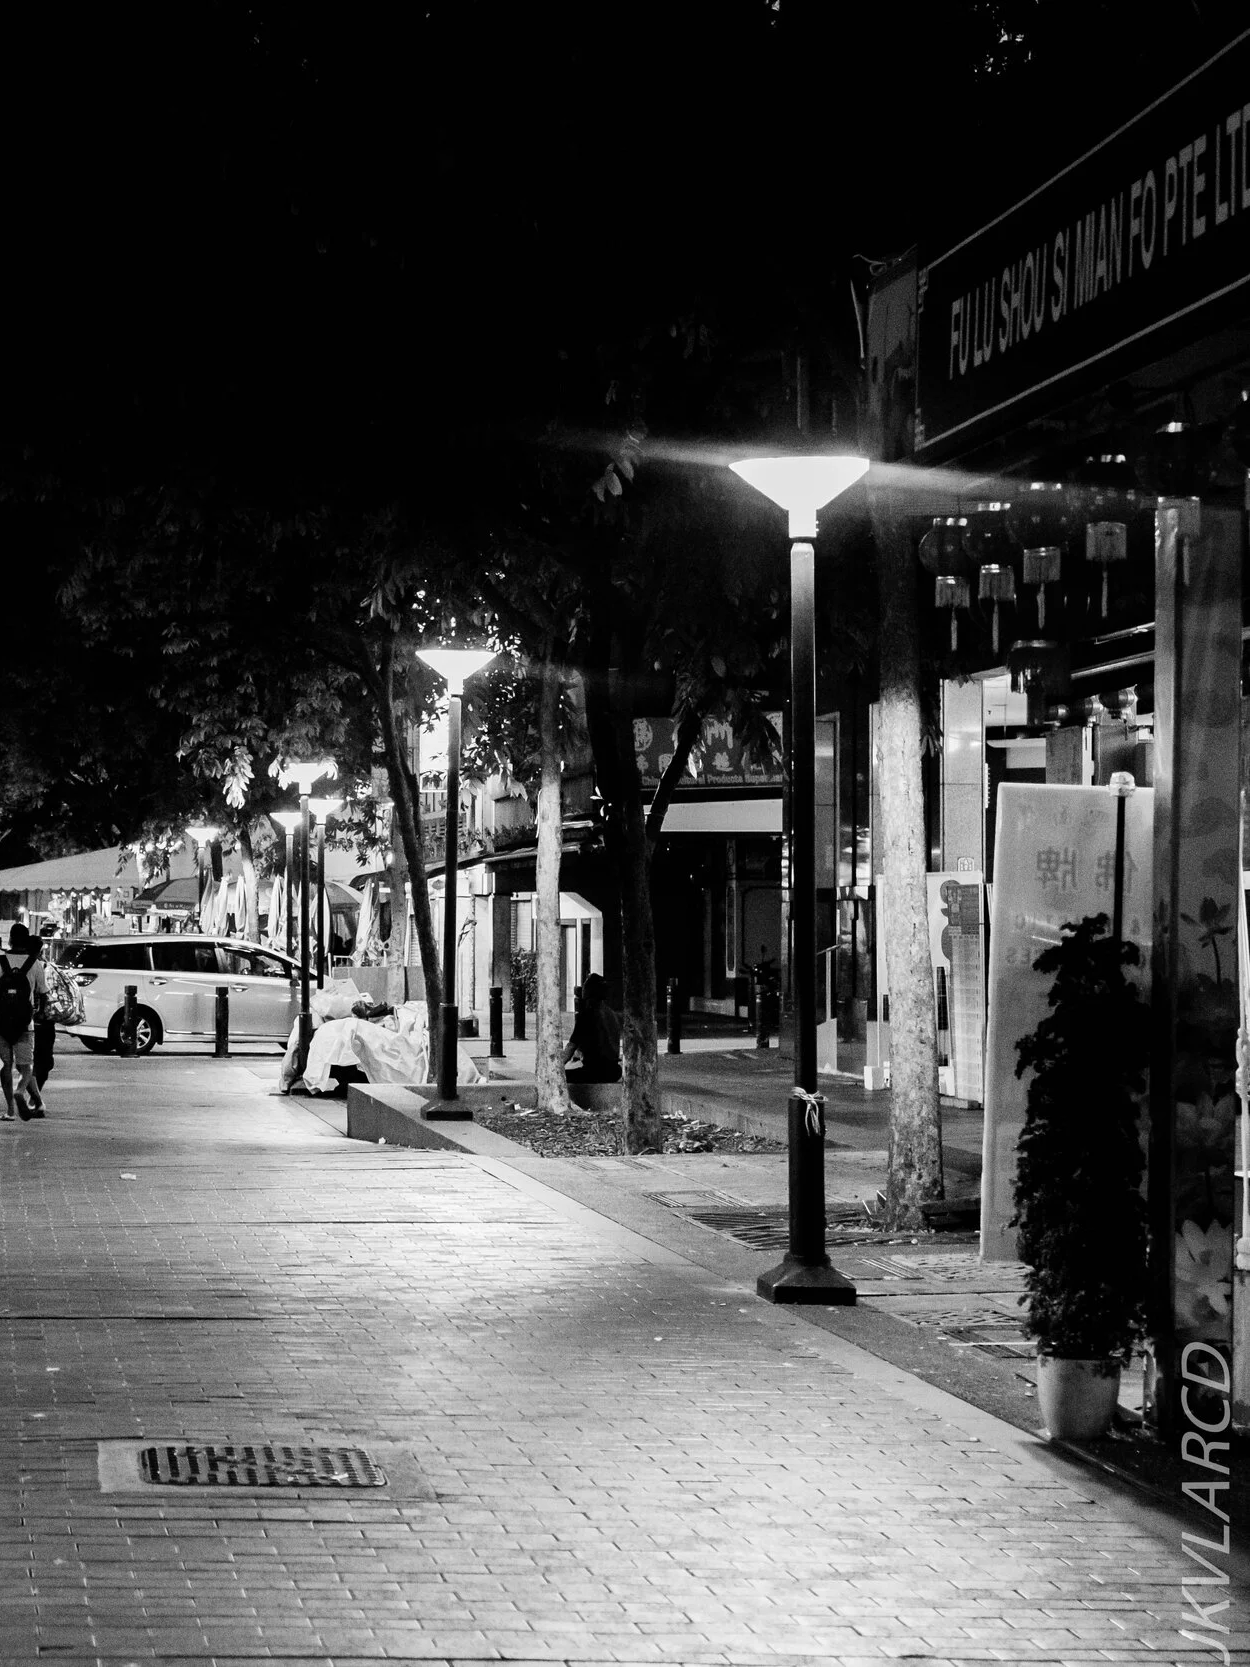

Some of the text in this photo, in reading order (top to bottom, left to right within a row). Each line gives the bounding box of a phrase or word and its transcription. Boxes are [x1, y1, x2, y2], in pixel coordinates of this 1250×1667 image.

[948, 292, 971, 380] FU
[973, 277, 996, 368] LU
[998, 243, 1048, 354] SHOU
[1050, 227, 1070, 323] SI
[1073, 191, 1125, 310] MIAN
[1127, 169, 1157, 279] FO
[1162, 133, 1207, 257] PTE
[707, 774, 743, 784] Products
